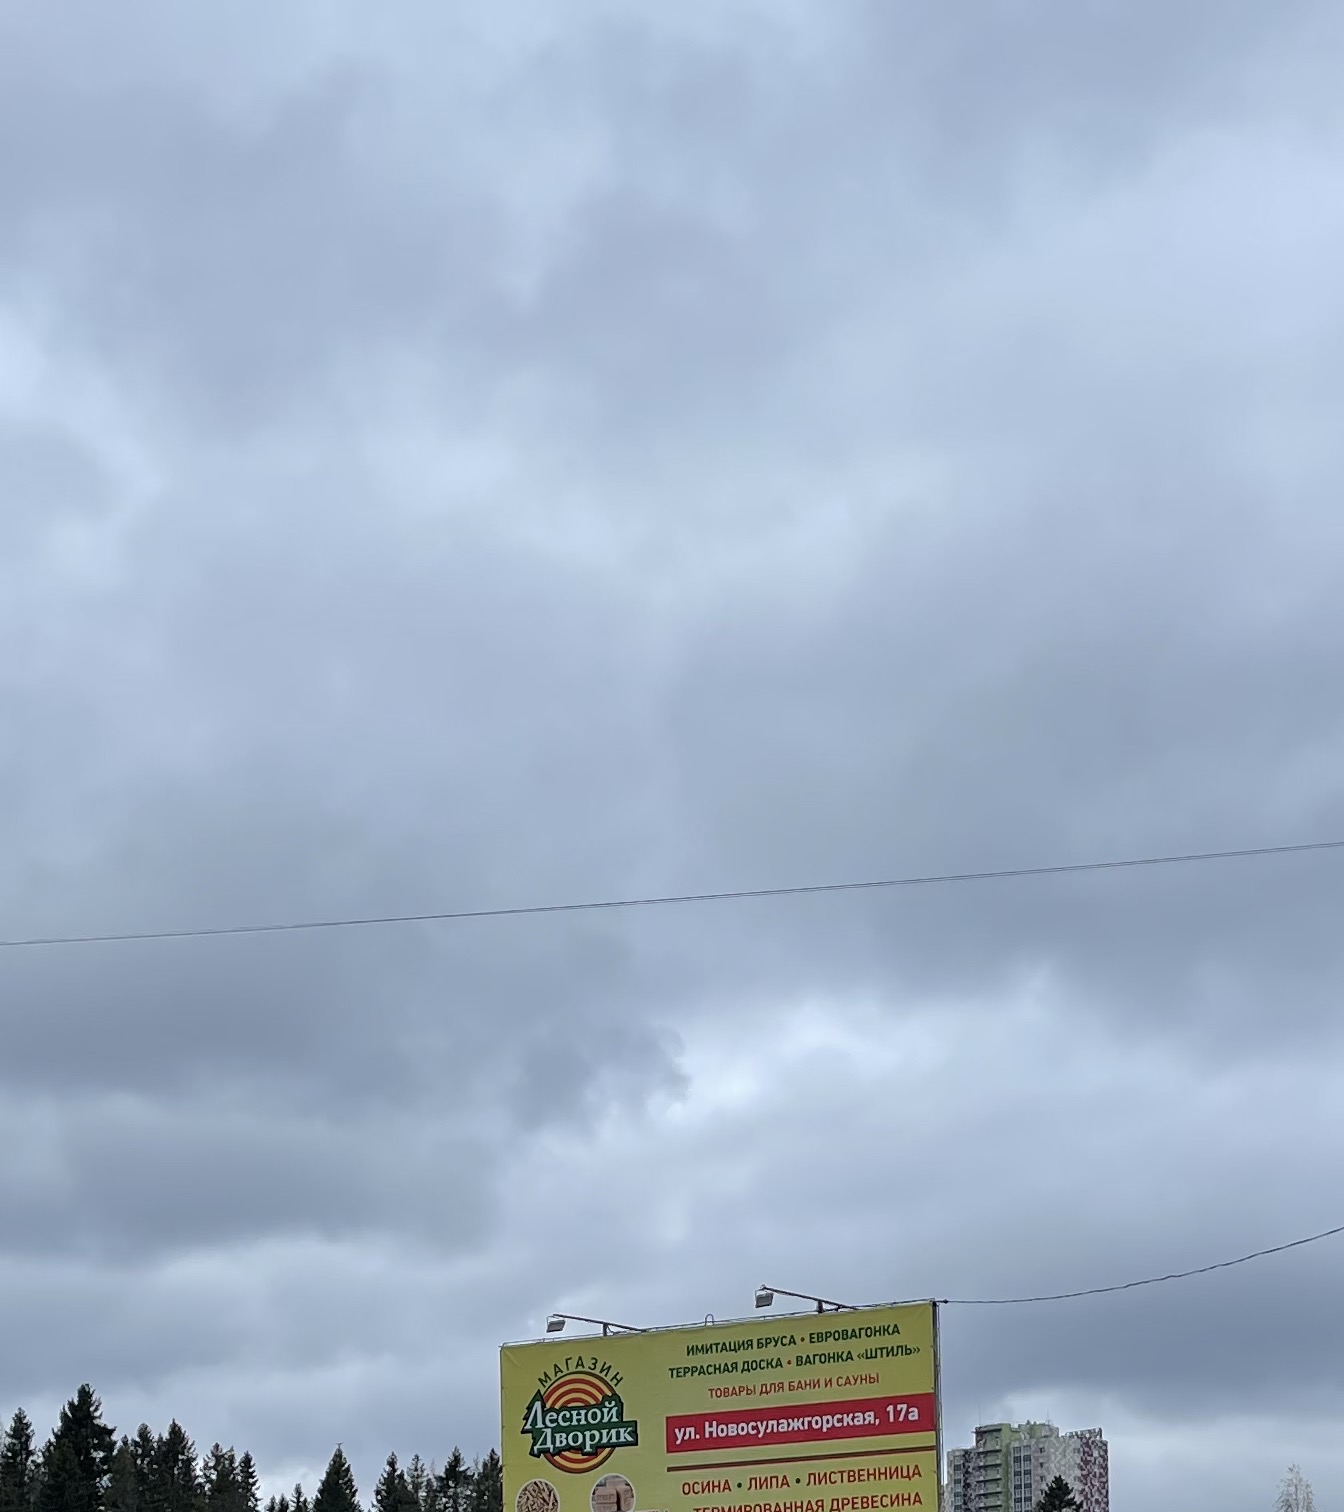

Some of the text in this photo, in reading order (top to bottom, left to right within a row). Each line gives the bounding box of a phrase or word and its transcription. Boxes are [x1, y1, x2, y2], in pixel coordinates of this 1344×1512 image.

[686, 1323, 901, 1357] ИМИТАЦИЯ БРУСА ЕВРОВАГОНКА
[537, 1355, 623, 1389] МАГАЗИН
[668, 1344, 921, 1379] ТЕРРАСНАЯ ДОСКА ВАГОНКА «ШТИЛЬ»
[708, 1372, 880, 1399] ТОВАРЫ ДЛЯ БАНИ И САУНЫ
[523, 1400, 620, 1430] Лесной
[674, 1403, 919, 1446] ул. Новосулажгорская, 17а
[534, 1426, 635, 1455] Дворик
[681, 1464, 923, 1496] ОСИНА ЛИПА ЛИСТВЕННИЦА
